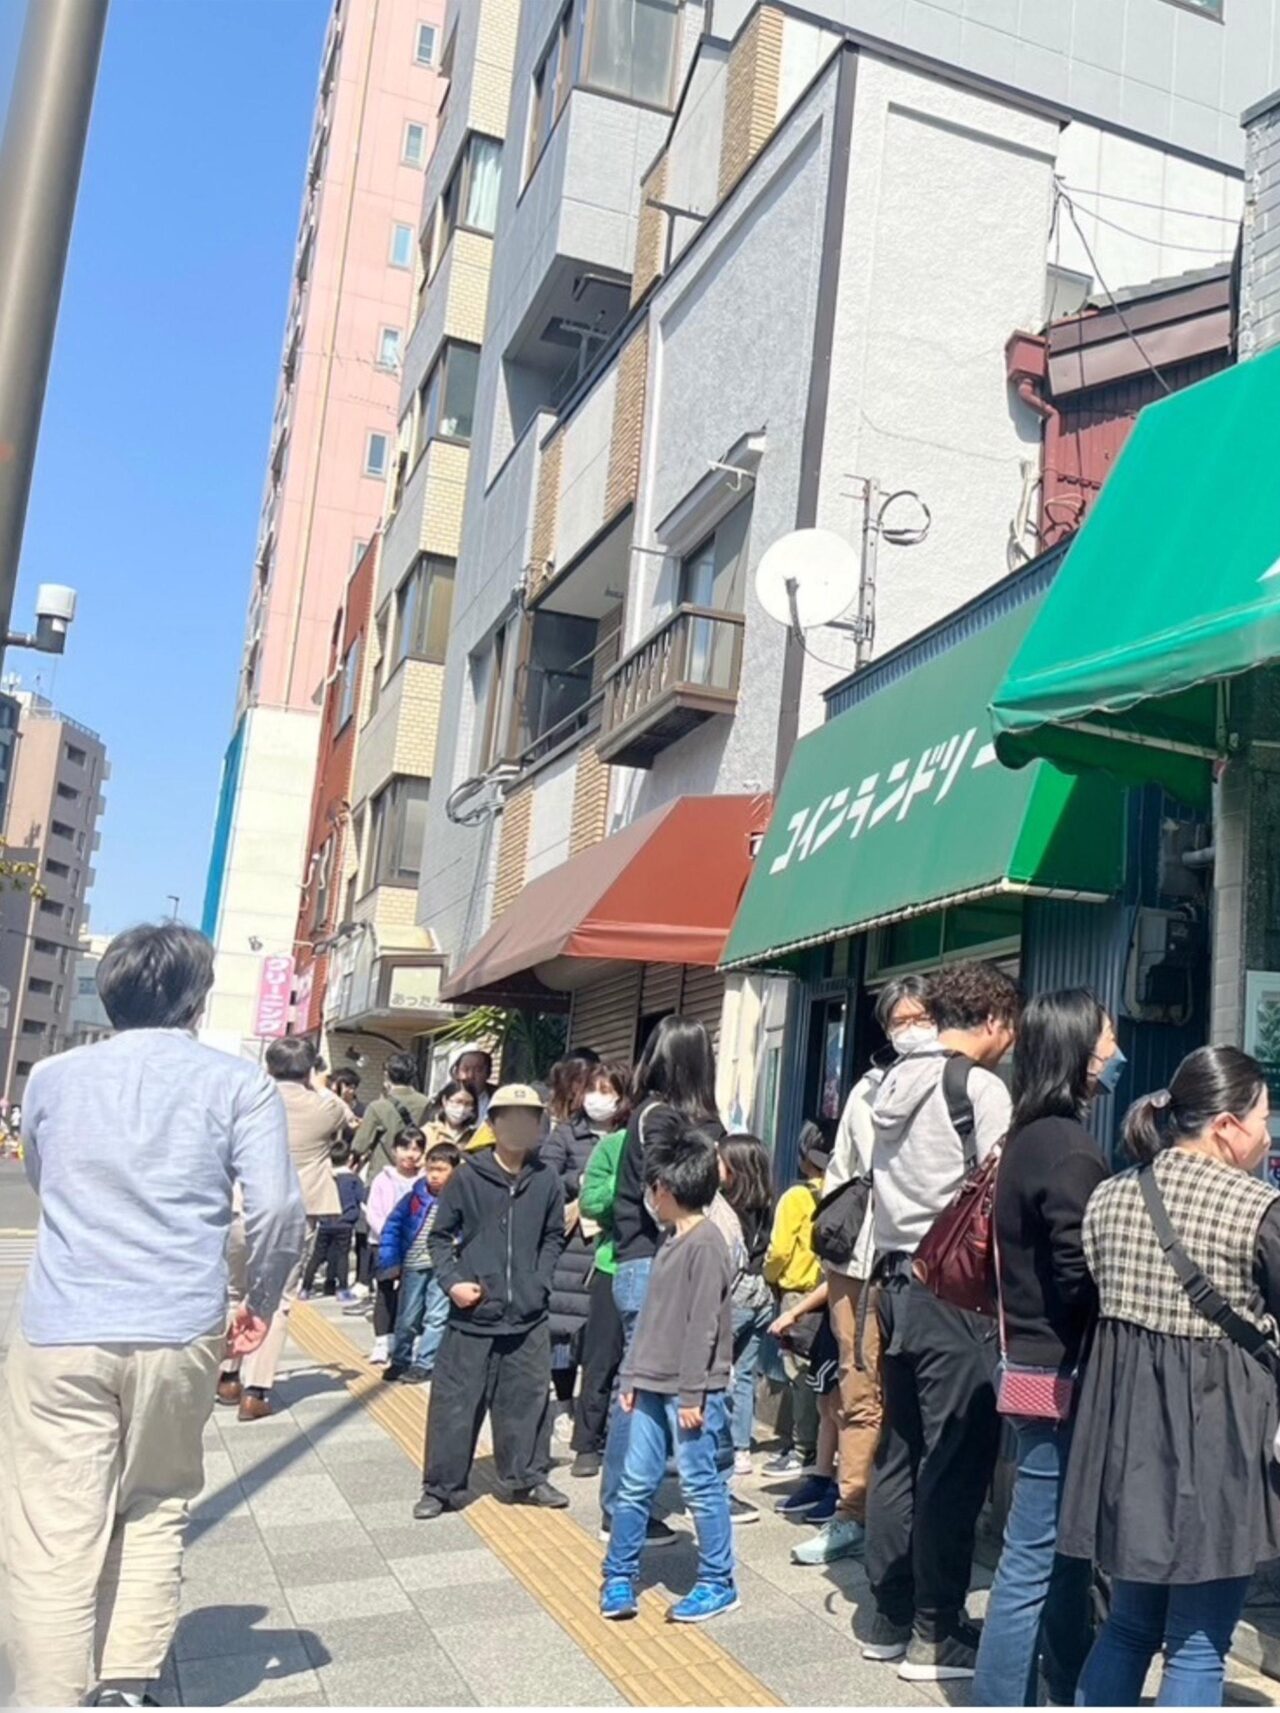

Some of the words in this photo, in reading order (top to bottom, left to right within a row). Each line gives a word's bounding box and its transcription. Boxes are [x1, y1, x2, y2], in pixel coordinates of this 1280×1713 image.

[257, 957, 290, 1033] クリーニング
